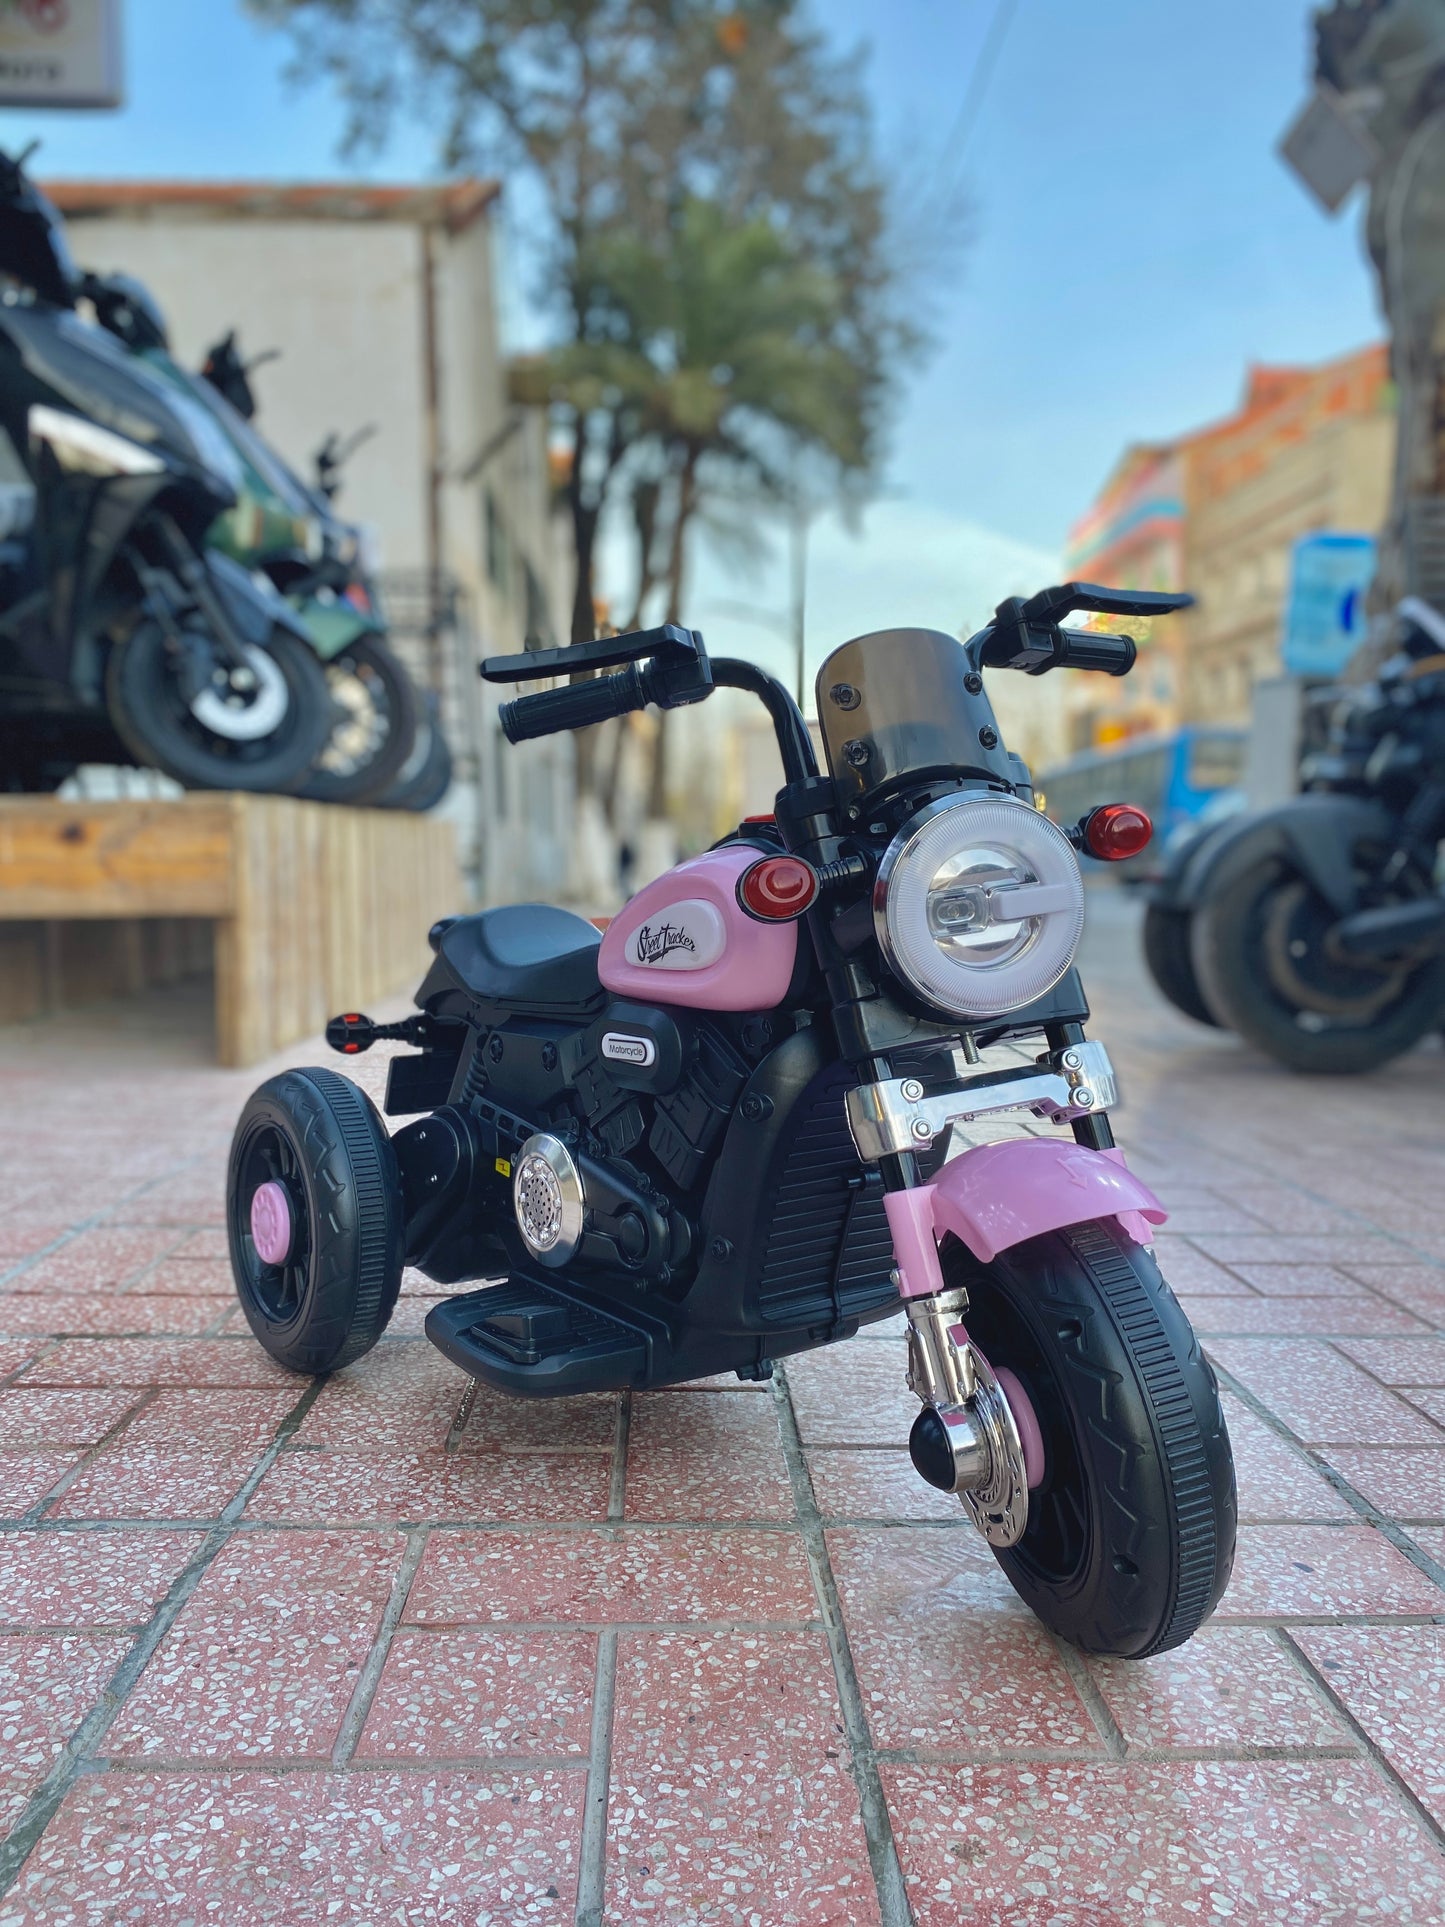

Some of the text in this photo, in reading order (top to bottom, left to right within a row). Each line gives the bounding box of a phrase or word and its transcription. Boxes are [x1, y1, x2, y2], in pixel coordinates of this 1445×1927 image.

[637, 923, 697, 962] Street Tracker
[609, 1044, 643, 1057] Motorcycle
